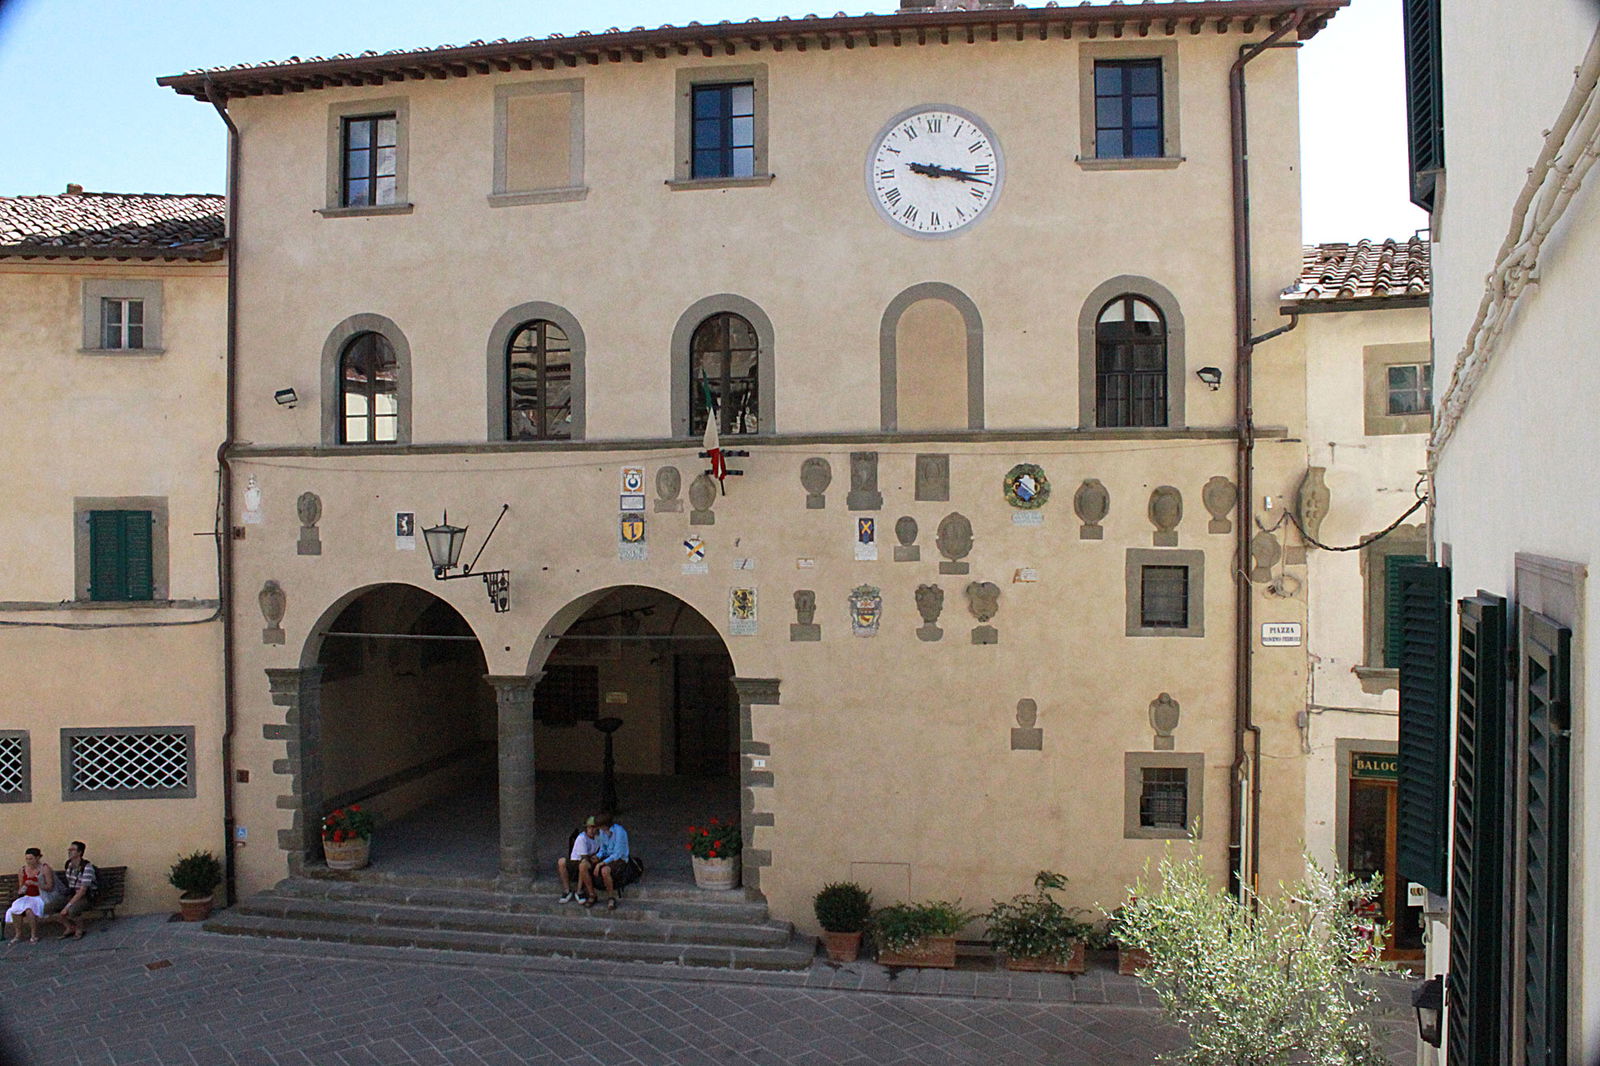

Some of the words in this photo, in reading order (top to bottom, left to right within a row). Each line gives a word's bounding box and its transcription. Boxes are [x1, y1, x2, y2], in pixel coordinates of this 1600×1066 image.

[903, 125, 918, 141] XI
[926, 119, 941, 134] XII
[953, 125, 962, 137] I
[968, 141, 983, 153] II
[884, 187, 902, 207] VIII
[903, 204, 919, 222] VII
